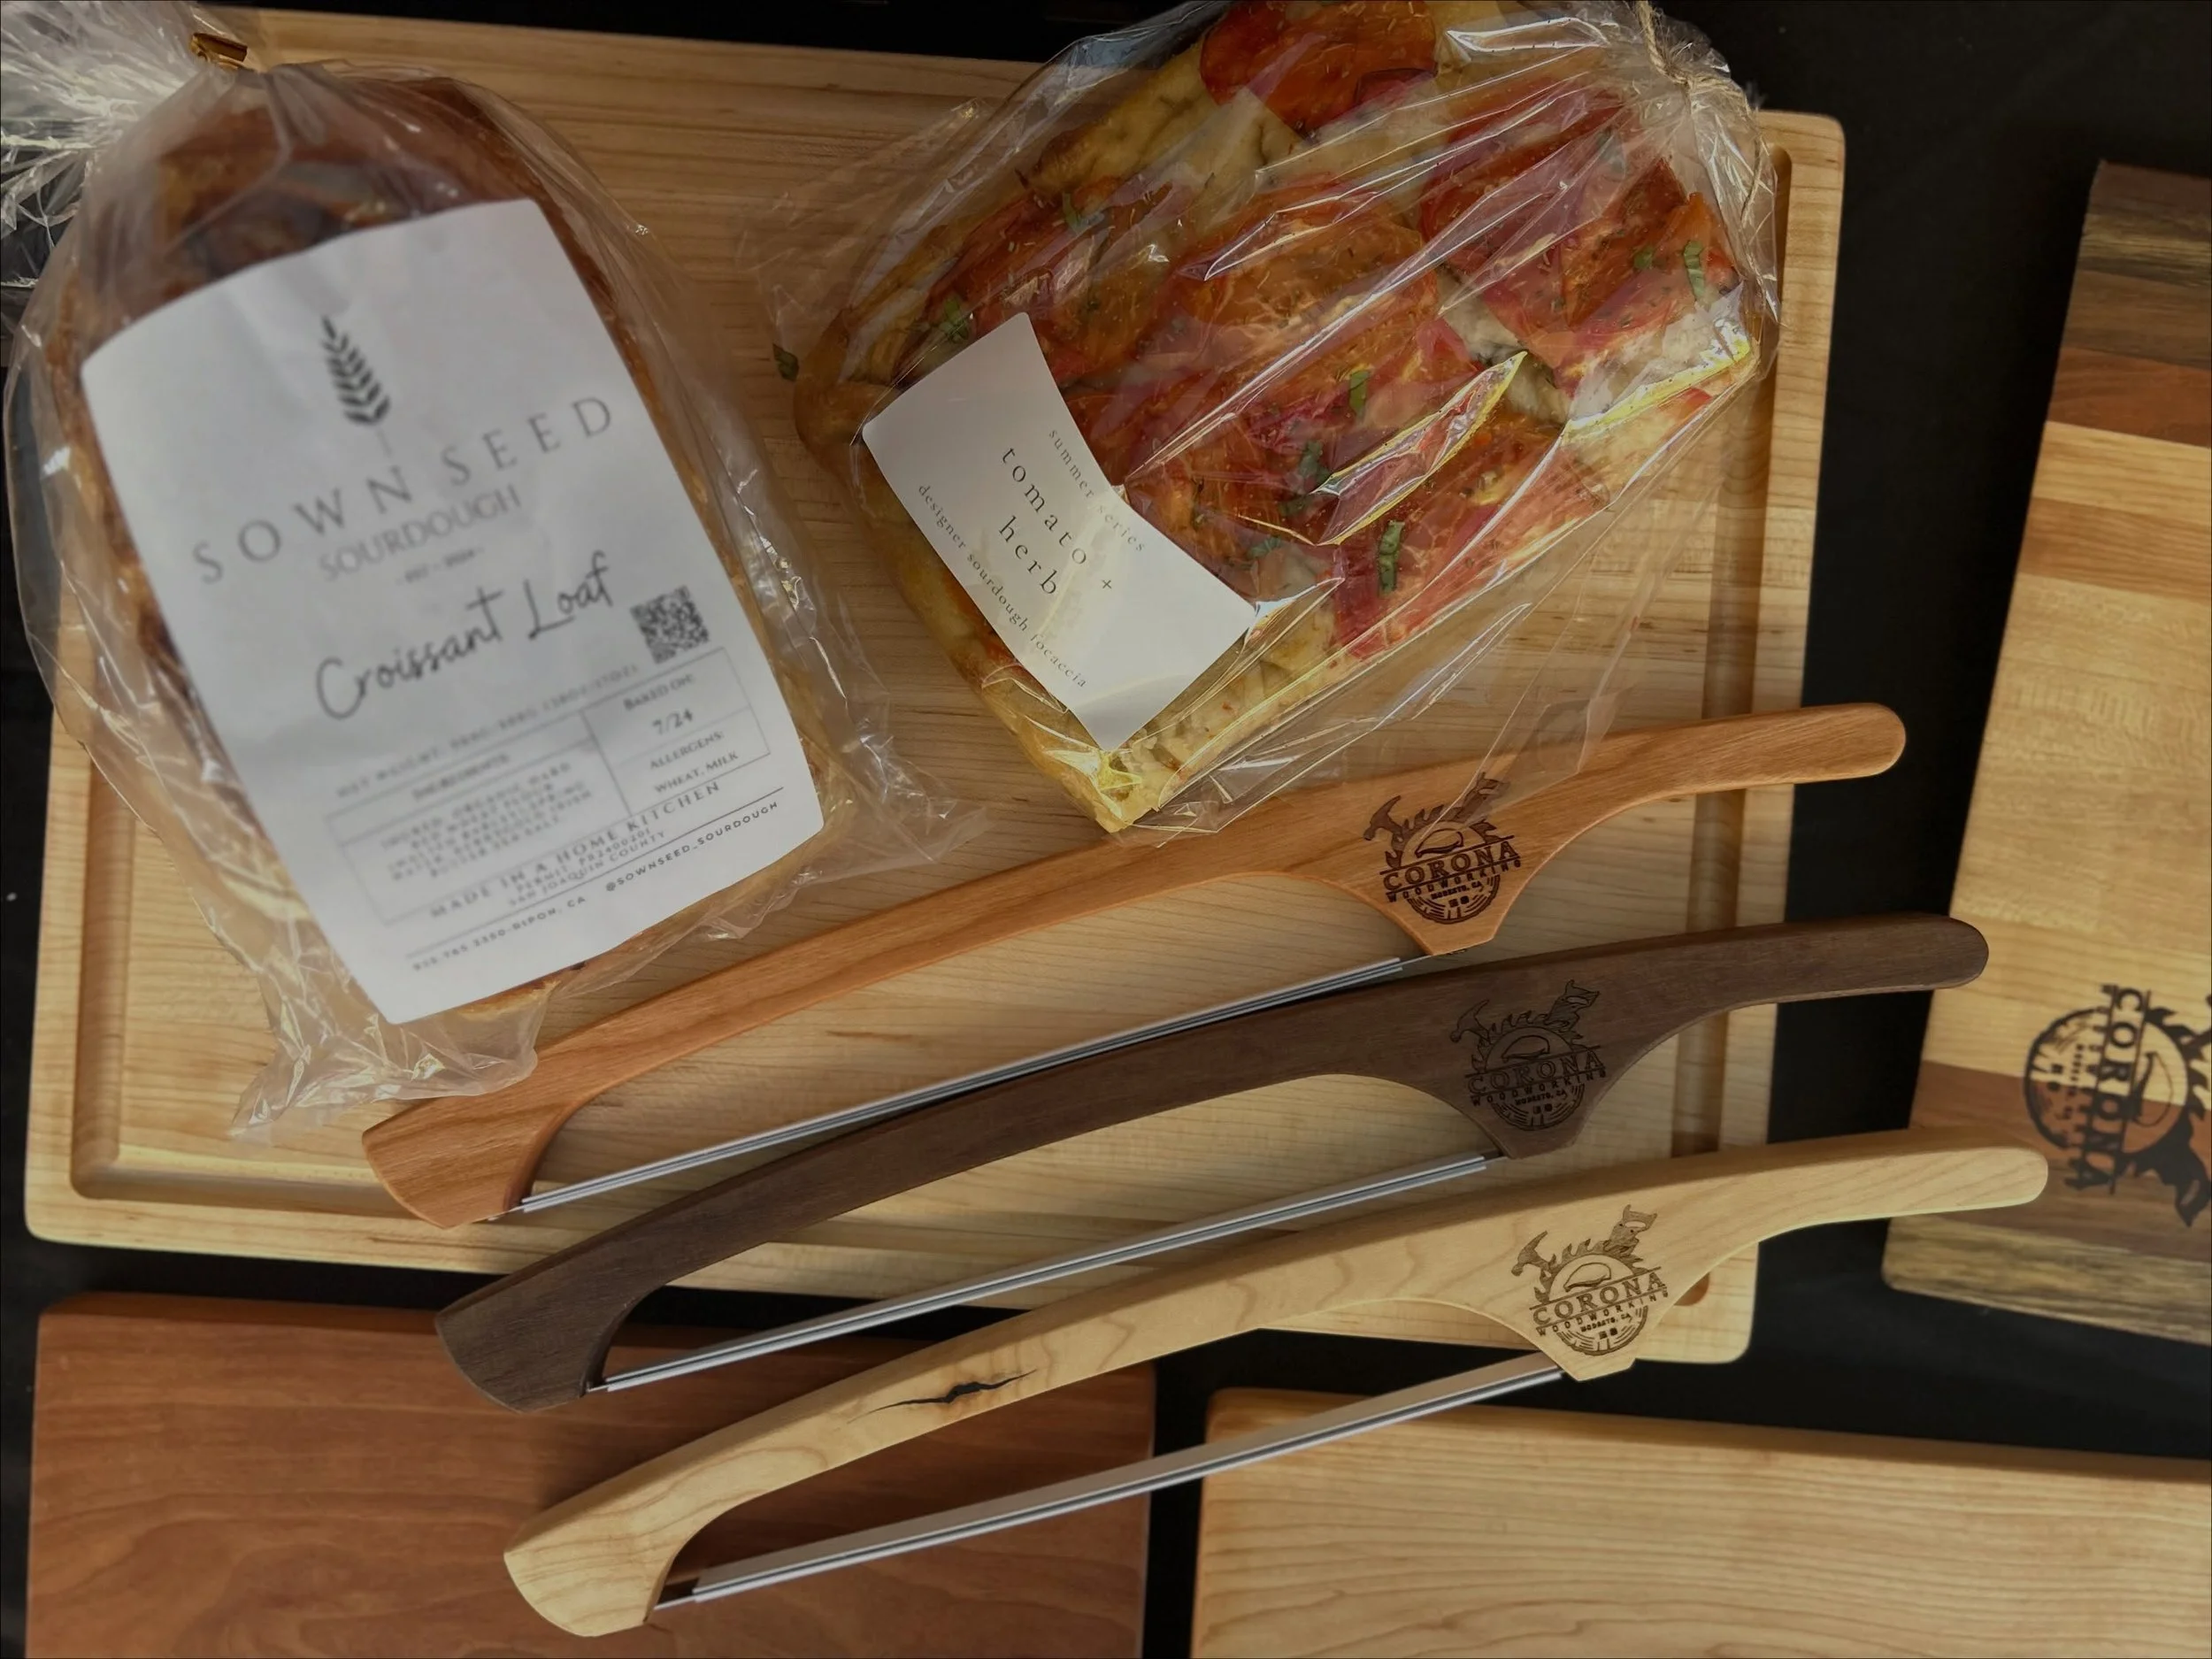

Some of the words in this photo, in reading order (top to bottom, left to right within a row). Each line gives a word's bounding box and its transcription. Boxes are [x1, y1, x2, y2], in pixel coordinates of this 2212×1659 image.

[192, 465, 413, 584] SOWN
[441, 396, 612, 487] SEED
[1002, 447, 1087, 565] tomato
[1102, 580, 1112, 590] +
[1048, 429, 1094, 498] summer
[1098, 503, 1145, 552] series
[319, 483, 522, 582] SOURDOUGH
[999, 515, 1057, 595] herb
[918, 485, 967, 550] designer
[967, 552, 1028, 632] sourdough
[1030, 633, 1087, 688] focaccia
[316, 586, 505, 721] Croissant
[524, 549, 613, 640] Loaf
[649, 731, 725, 770] ALLERGENS:
[706, 750, 740, 776] MILK
[431, 884, 492, 918] MADE
[500, 869, 527, 889] IN
[534, 862, 548, 874] A
[557, 828, 619, 864] HOME
[626, 780, 720, 833] KITCHEN
[541, 859, 603, 901] JOAQUIN
[611, 830, 666, 869] COUNTY
[605, 801, 779, 892] @SOWNSEED_SOURDOUGH
[1383, 840, 1520, 891] CORONA
[1386, 858, 1521, 903] WOODWORKING
[566, 895, 587, 910] CA
[1469, 1049, 1605, 1094] CORONA
[1470, 1070, 1607, 1107] WOODWORKING
[2080, 987, 2144, 1187] CORONA
[1532, 1272, 1665, 1325] CORONA
[1535, 1291, 1669, 1338] WOODWORKING
